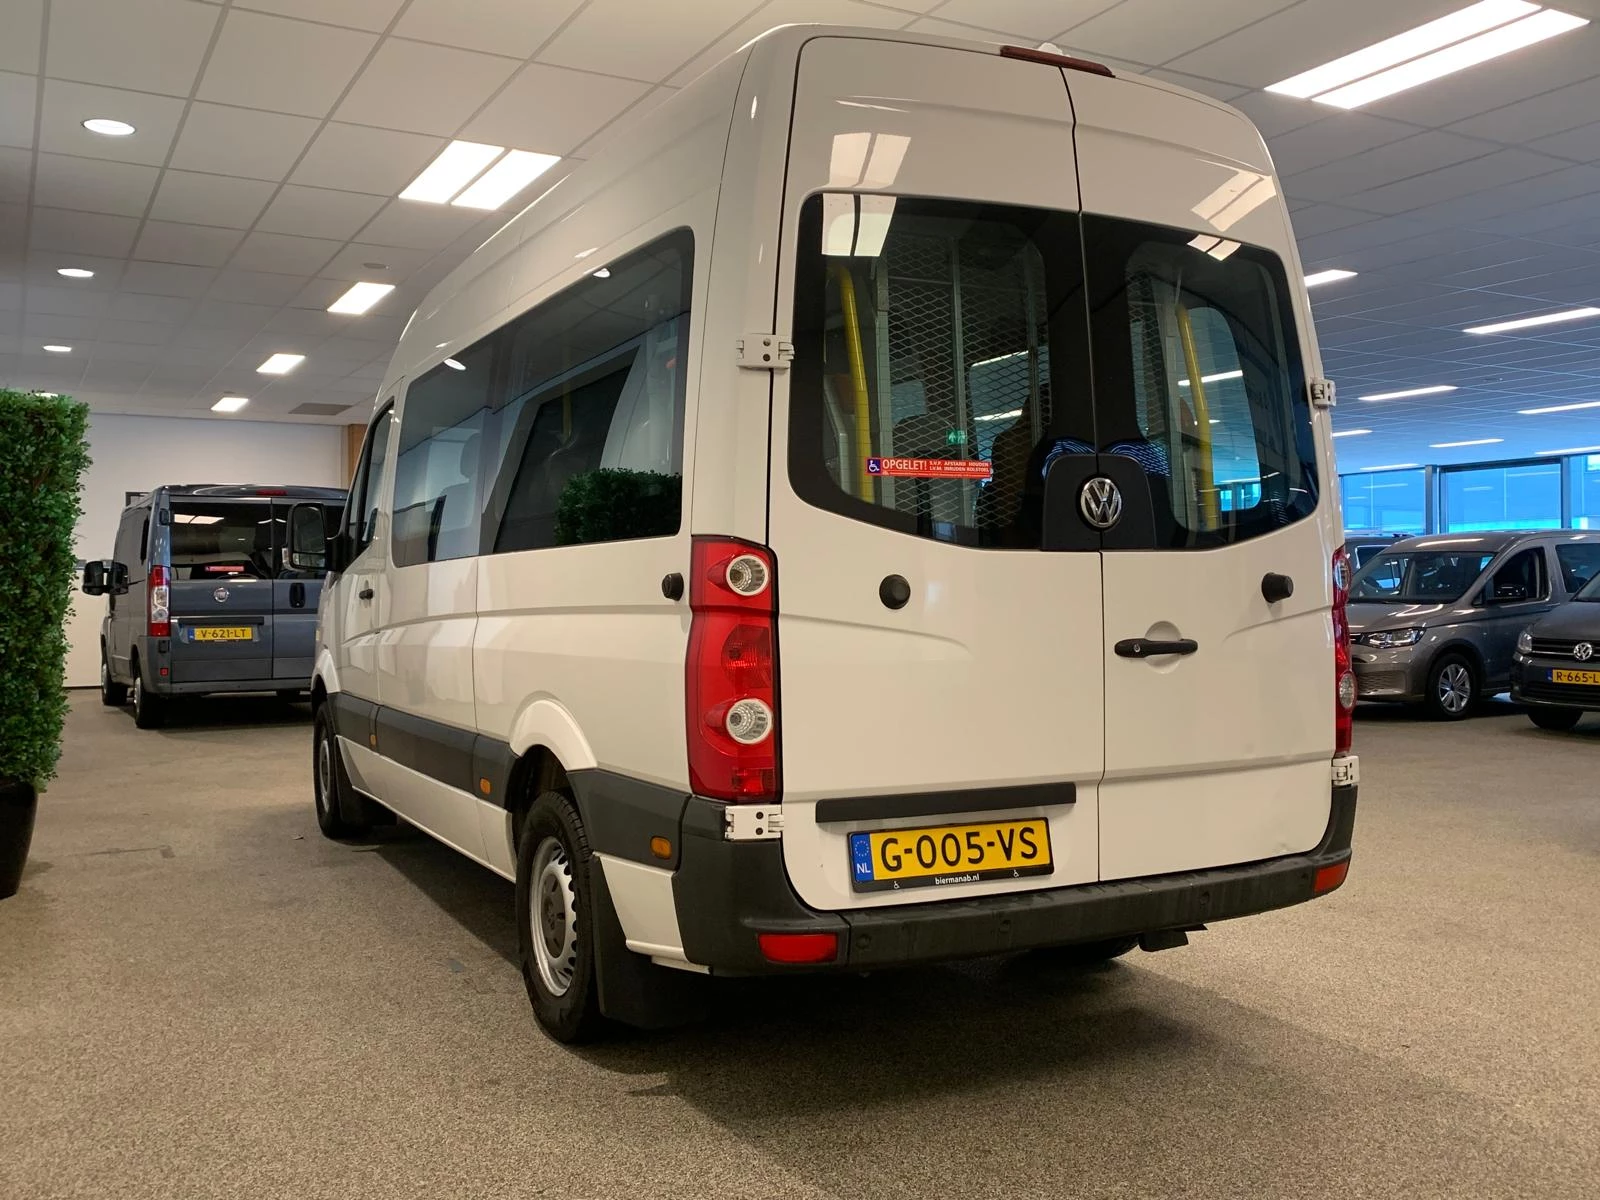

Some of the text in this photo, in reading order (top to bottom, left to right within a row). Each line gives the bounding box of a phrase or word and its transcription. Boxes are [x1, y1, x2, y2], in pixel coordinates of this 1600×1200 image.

[882, 459, 927, 470] OPGELET!
[200, 629, 246, 638] V-621-LT
[880, 827, 1038, 872] G-005-VS
[856, 862, 871, 874] NL
[934, 873, 980, 885] biermanab.nl
